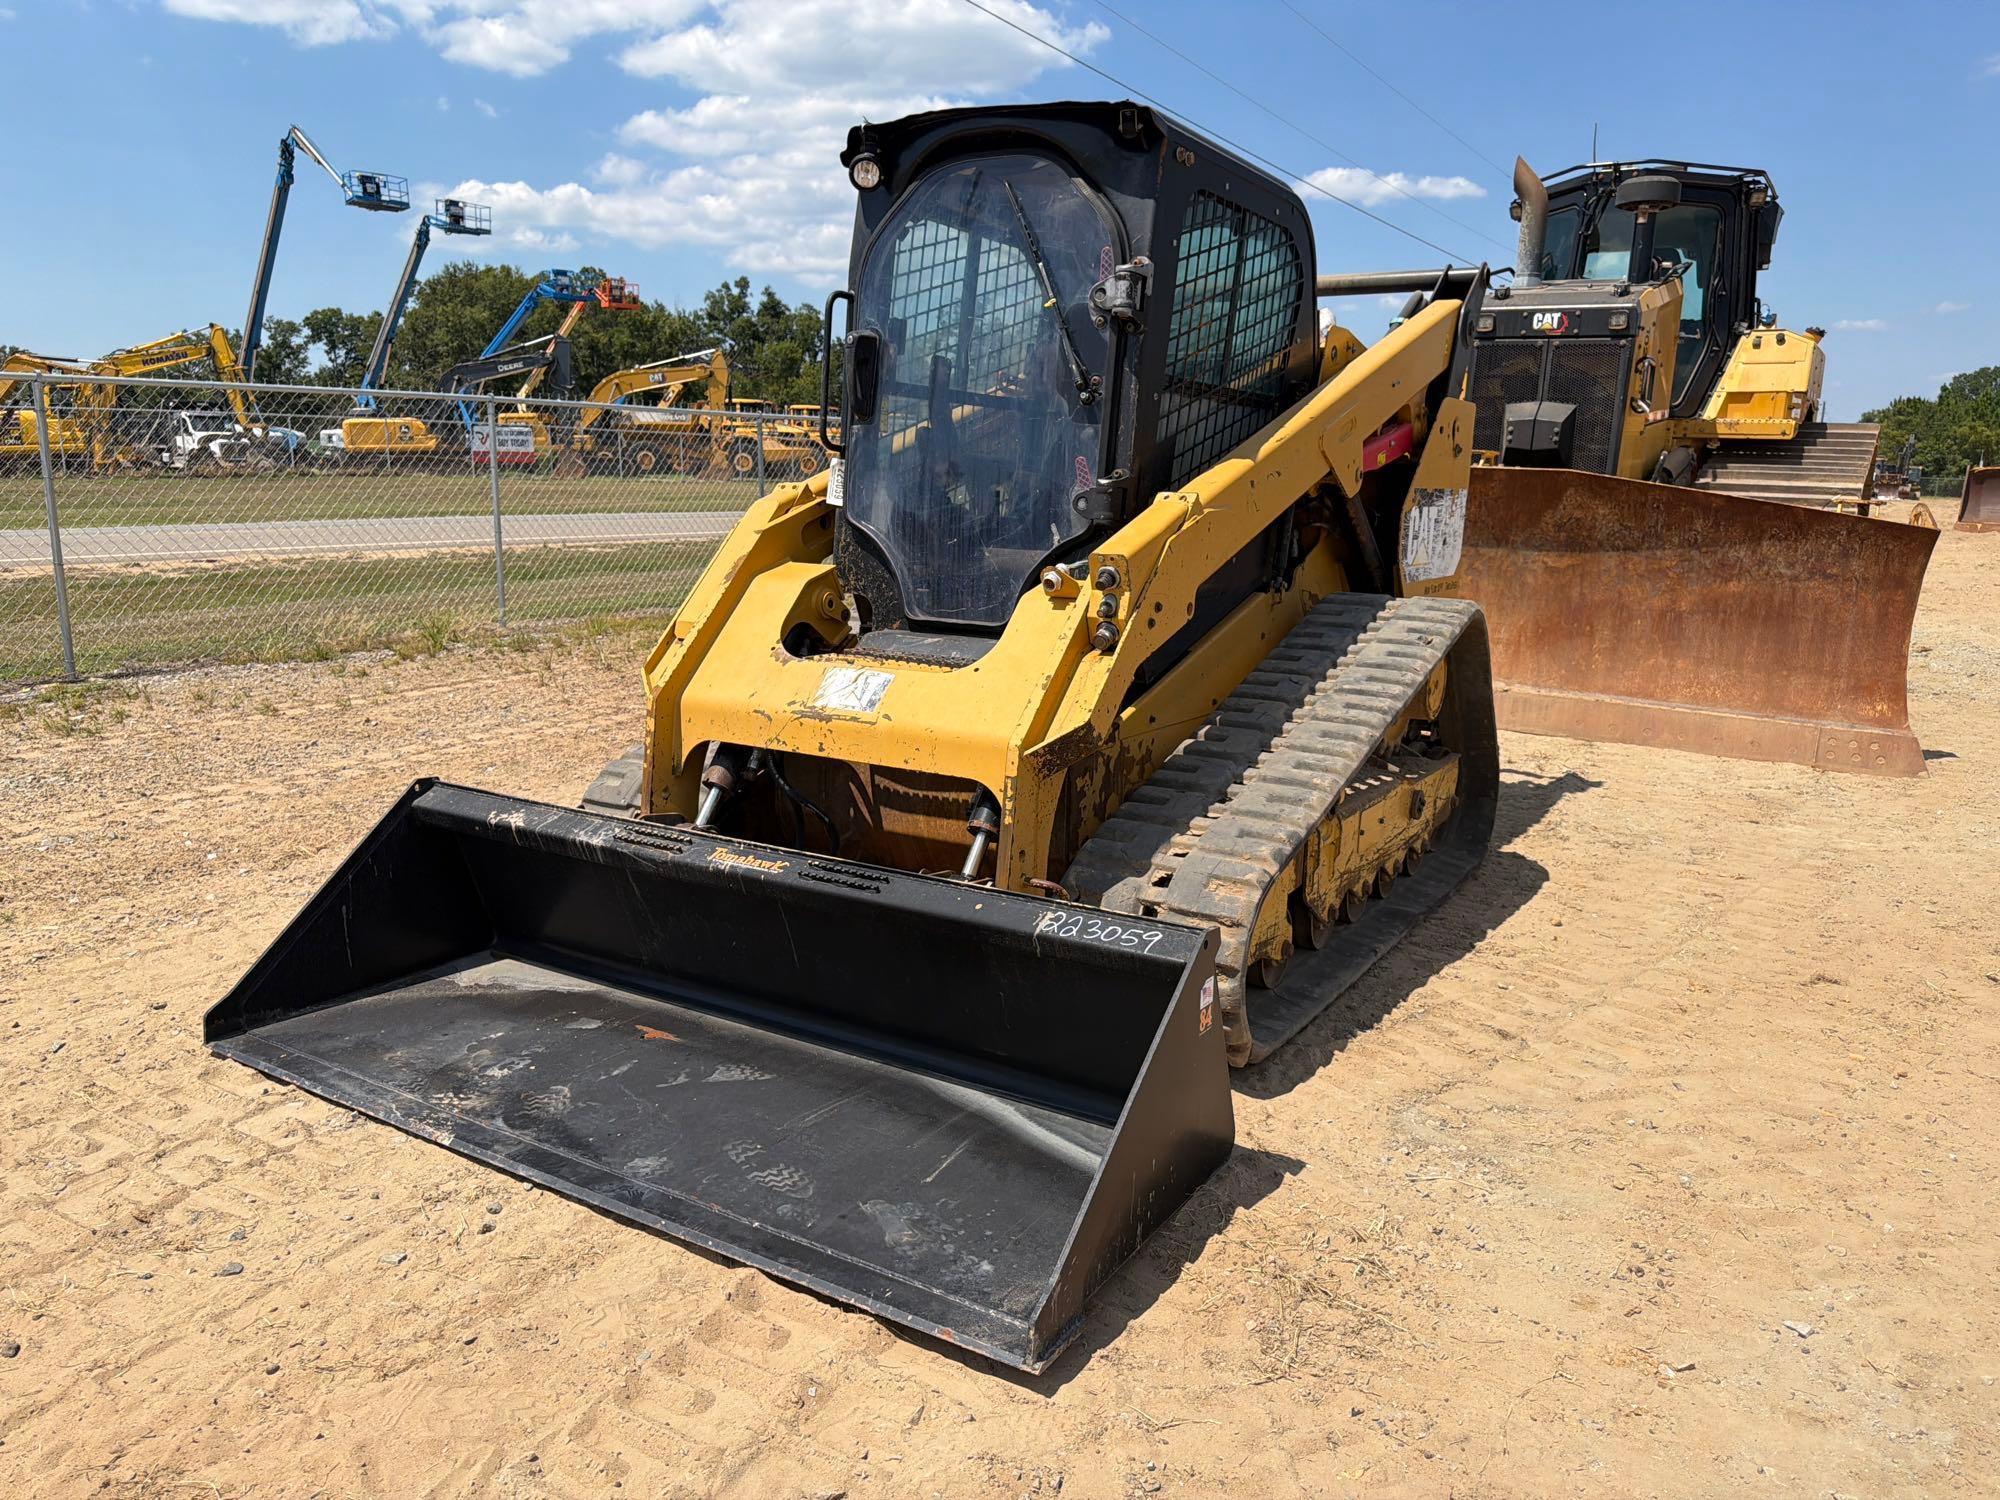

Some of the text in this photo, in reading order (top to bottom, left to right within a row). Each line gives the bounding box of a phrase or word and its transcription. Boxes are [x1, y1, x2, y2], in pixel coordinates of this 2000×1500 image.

[1533, 312, 1561, 330] CAT
[142, 351, 188, 366] KOMATSU
[497, 361, 524, 372] DEERE
[649, 373, 663, 383] CAT
[833, 468, 845, 500] 223059
[707, 847, 790, 873] Tomahawk
[1041, 911, 1163, 954] 223059
[1200, 1005, 1213, 1032] 84
